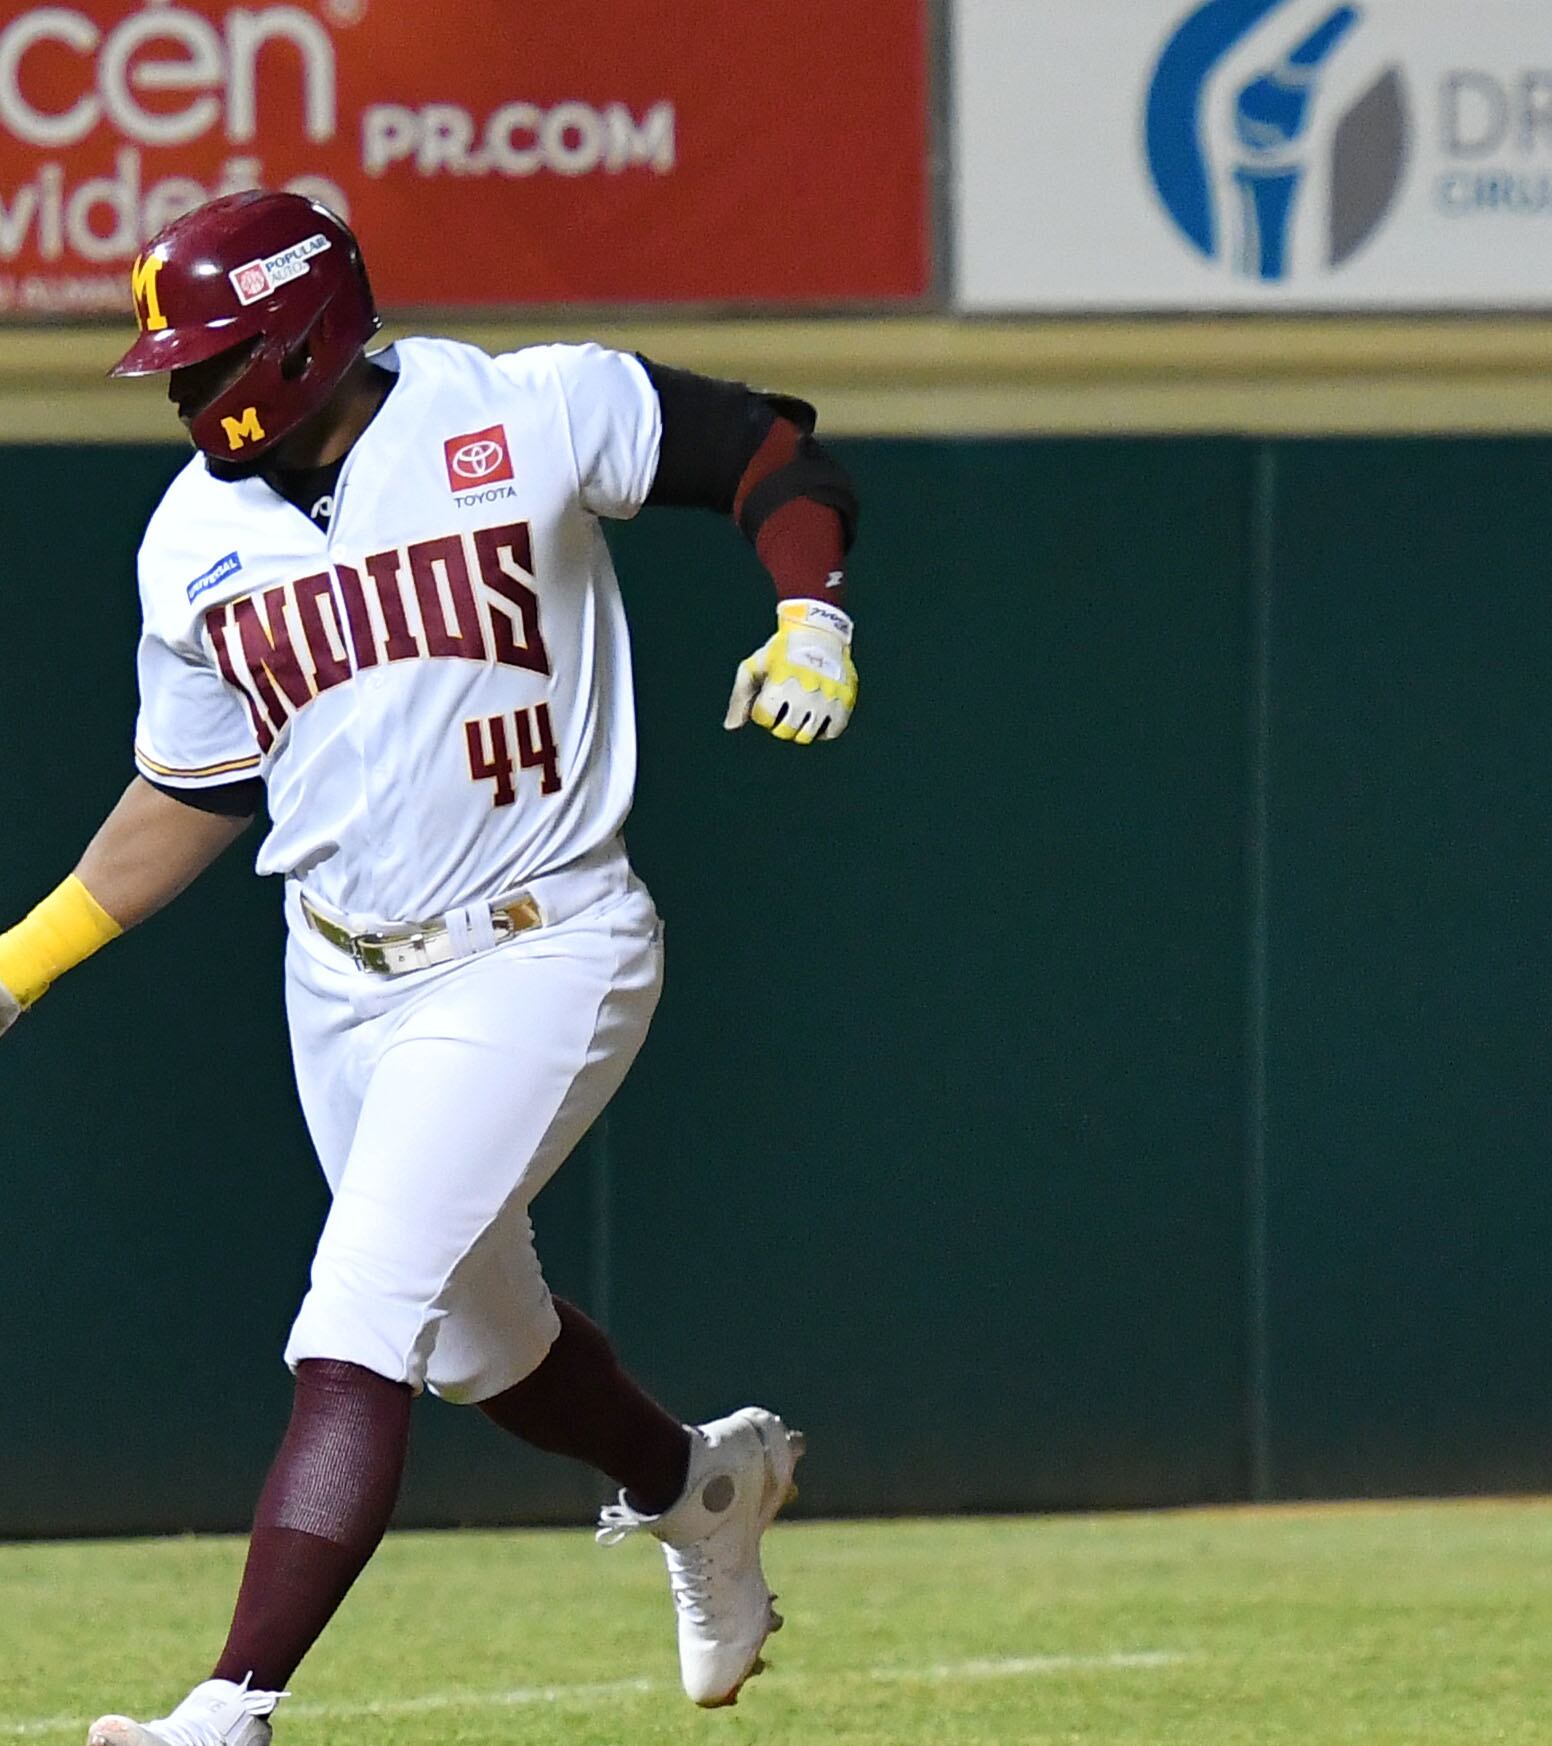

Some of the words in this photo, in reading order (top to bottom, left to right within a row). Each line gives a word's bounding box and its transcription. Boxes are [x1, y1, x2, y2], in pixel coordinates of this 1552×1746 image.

[364, 101, 676, 176] PR.COM
[265, 236, 327, 272] POPULAR
[221, 407, 265, 452] M
[454, 487, 517, 509] TOYOTA
[204, 521, 551, 756] INDIOS
[464, 702, 562, 807] 44
